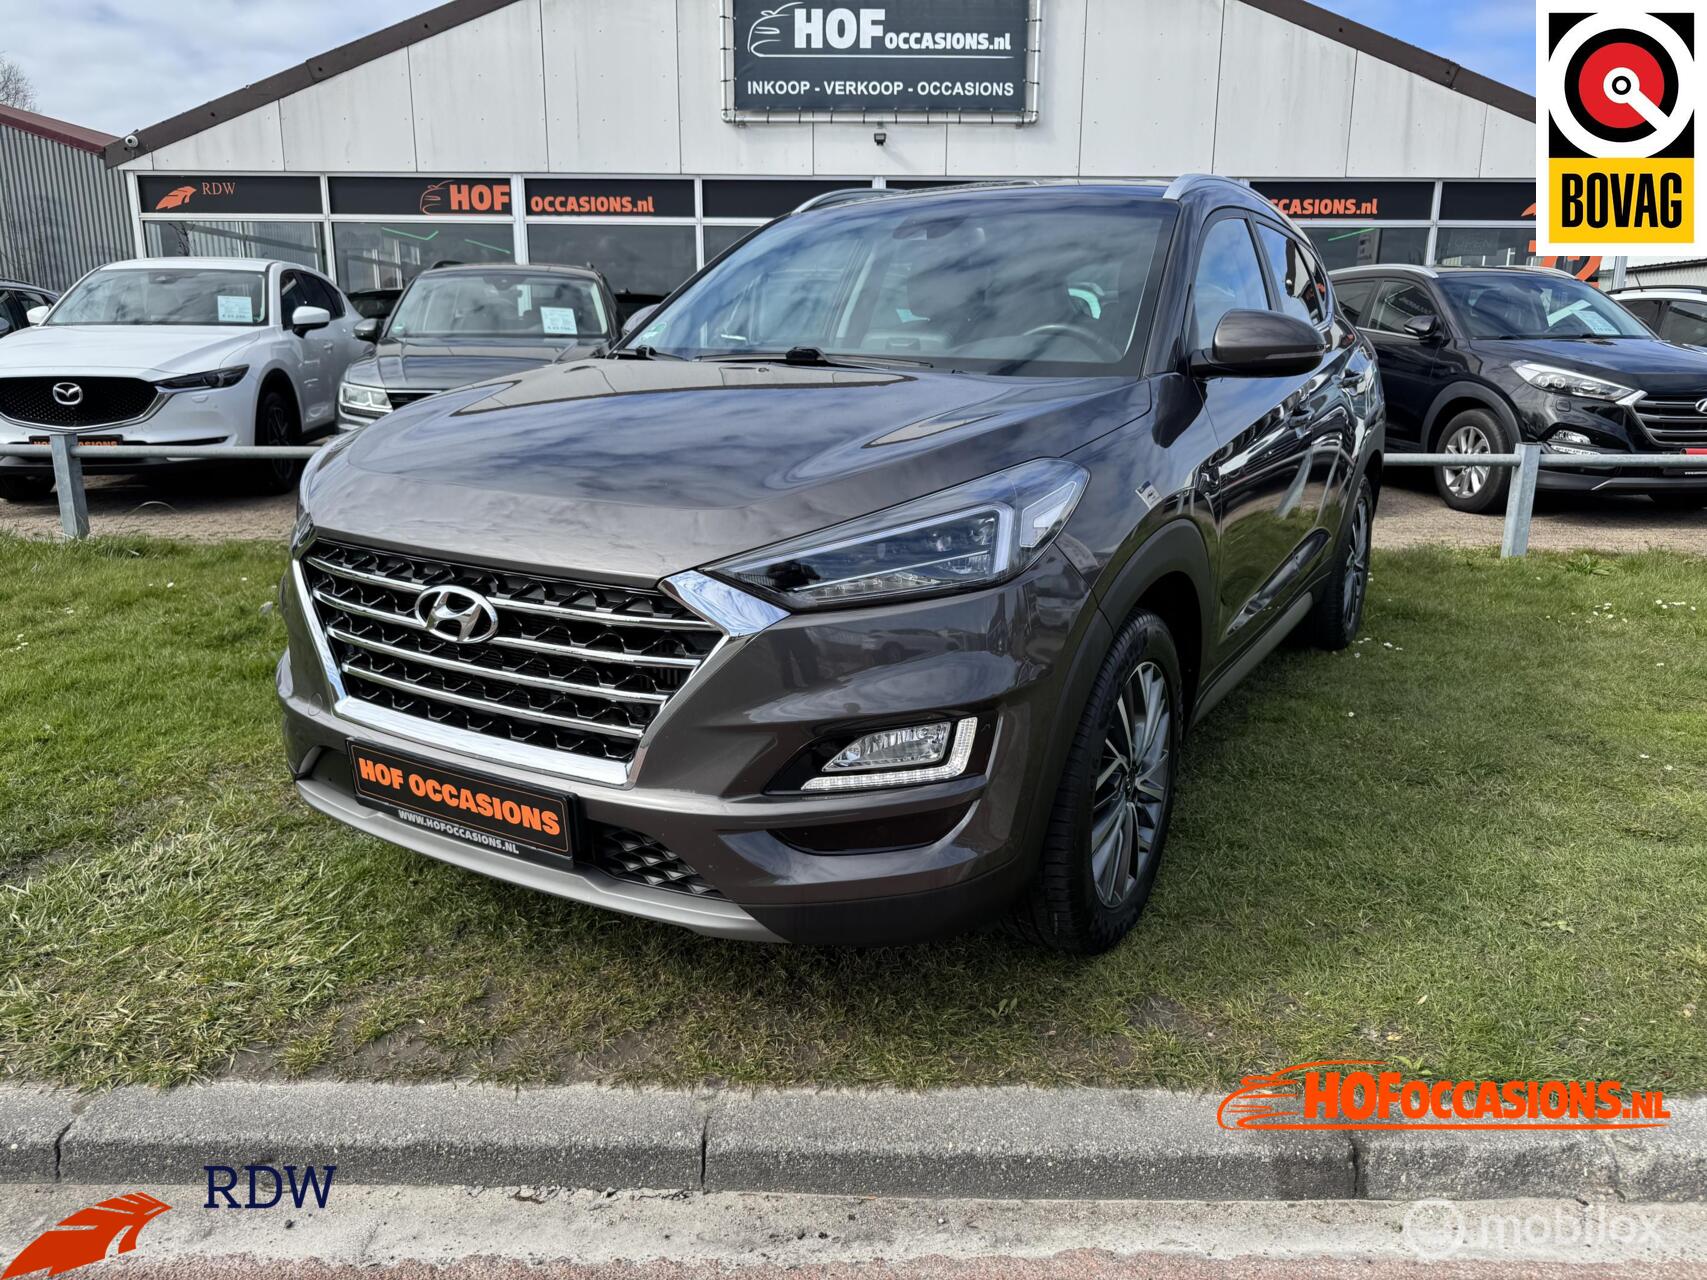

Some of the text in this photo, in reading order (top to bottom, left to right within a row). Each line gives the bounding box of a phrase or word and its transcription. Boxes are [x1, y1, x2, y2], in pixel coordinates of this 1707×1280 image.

[748, 81, 810, 95] INKOOP
[824, 81, 904, 95] VERKOOP
[918, 81, 1014, 96] OCCASIONS
[202, 182, 236, 195] RDW
[450, 184, 655, 213] HOF OCCASIONS.nl
[1271, 198, 1378, 215] CASIONS.nl
[358, 757, 561, 836] HOF OCCASIONS
[398, 810, 519, 854] WWW.HOFOCCASIONS.NL
